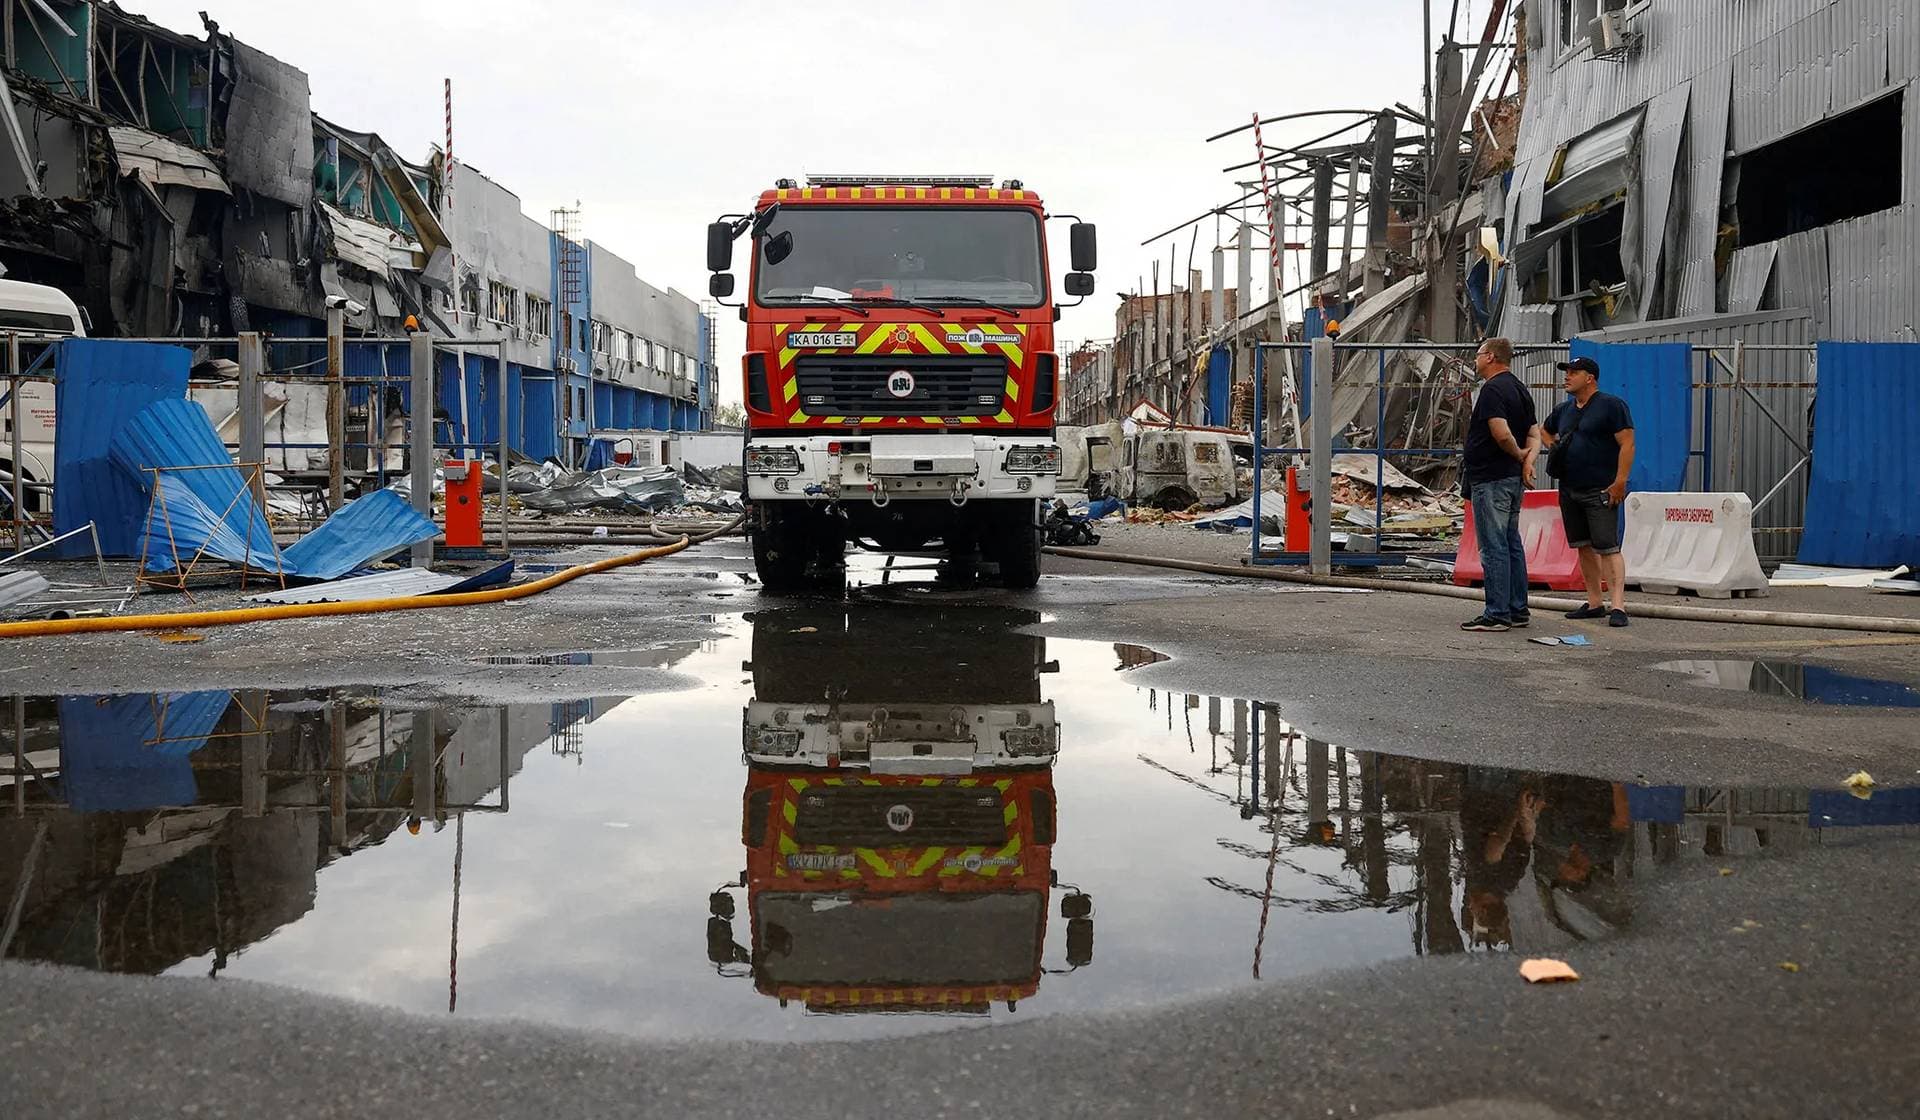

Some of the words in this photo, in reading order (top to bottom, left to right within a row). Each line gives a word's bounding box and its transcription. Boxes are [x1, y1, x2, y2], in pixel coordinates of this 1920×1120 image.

[794, 334, 810, 345] KA
[812, 334, 831, 345] 016
[834, 334, 842, 345] E
